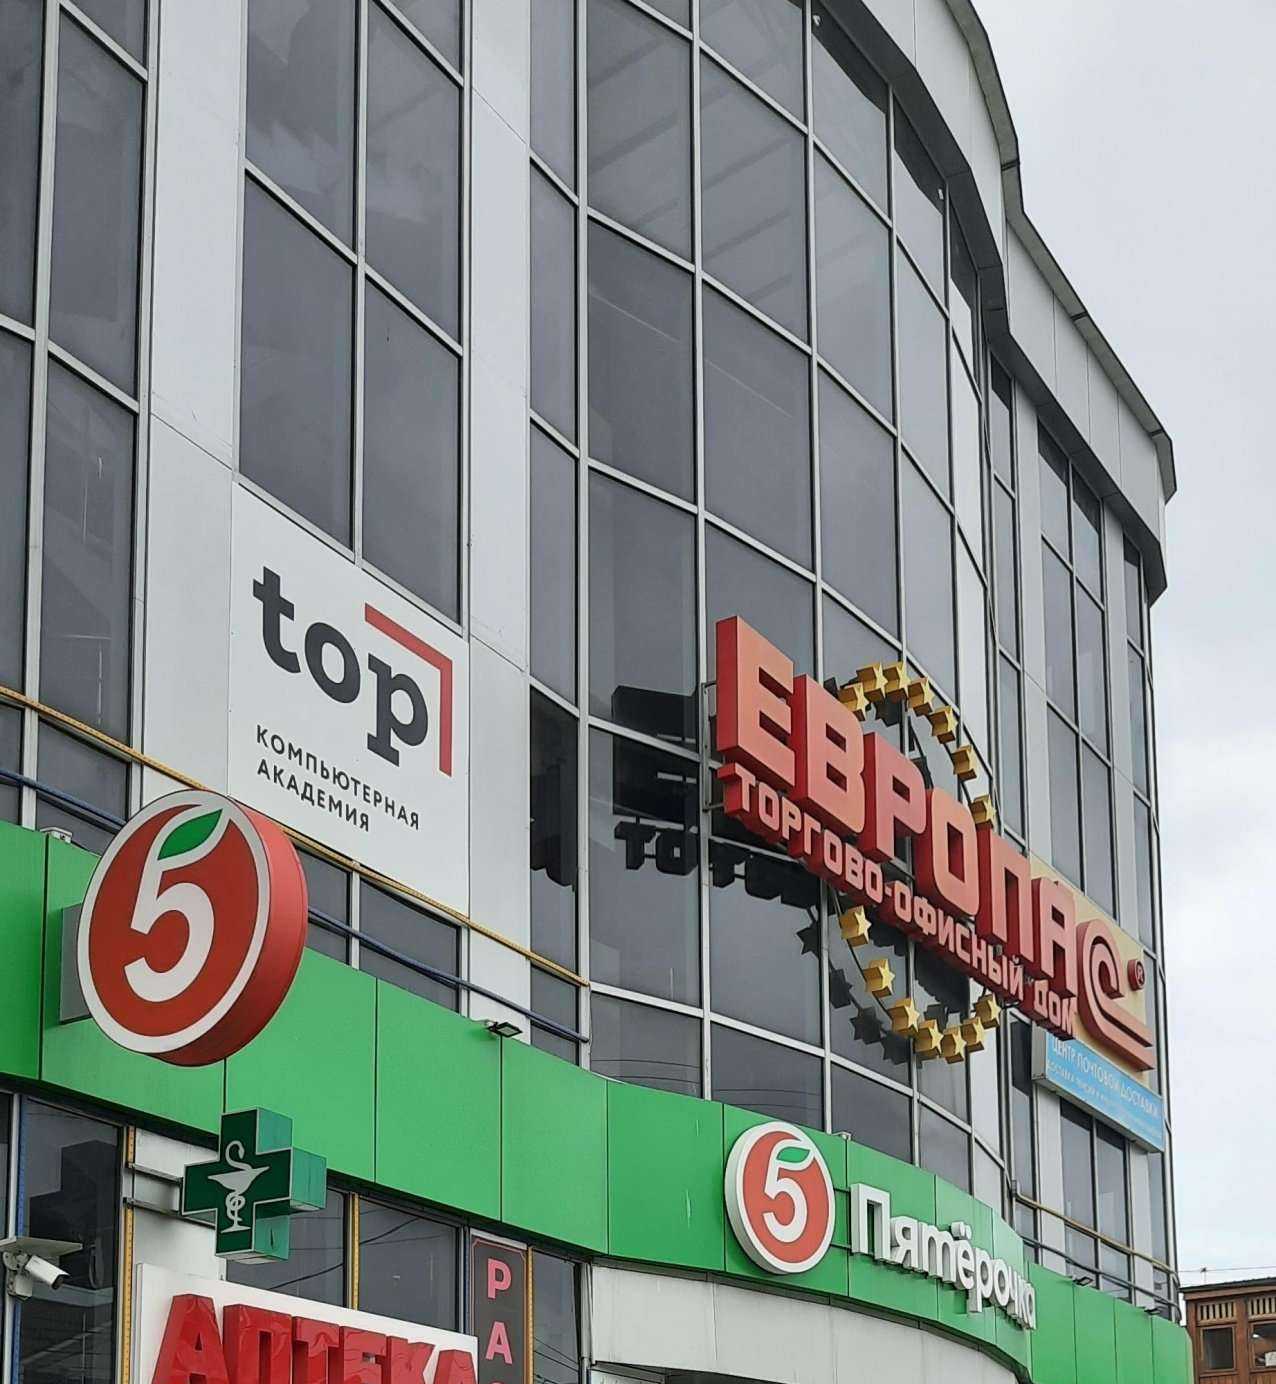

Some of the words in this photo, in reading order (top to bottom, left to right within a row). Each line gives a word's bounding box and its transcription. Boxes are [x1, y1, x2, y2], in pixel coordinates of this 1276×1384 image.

[253, 566, 429, 768] top
[256, 724, 420, 831] КОМПЬЮТЕРНАЯ
[256, 758, 370, 832] АКАДЕМИЯ
[716, 615, 1078, 998] ЕВРОПА
[123, 800, 230, 1004] 5
[720, 762, 1025, 1001] ТОРГОВО-ОФИСНЫЙ
[1031, 979, 1076, 1039] ДОМ
[763, 1138, 814, 1243] 5
[850, 1183, 1037, 1331] Пятёрочка
